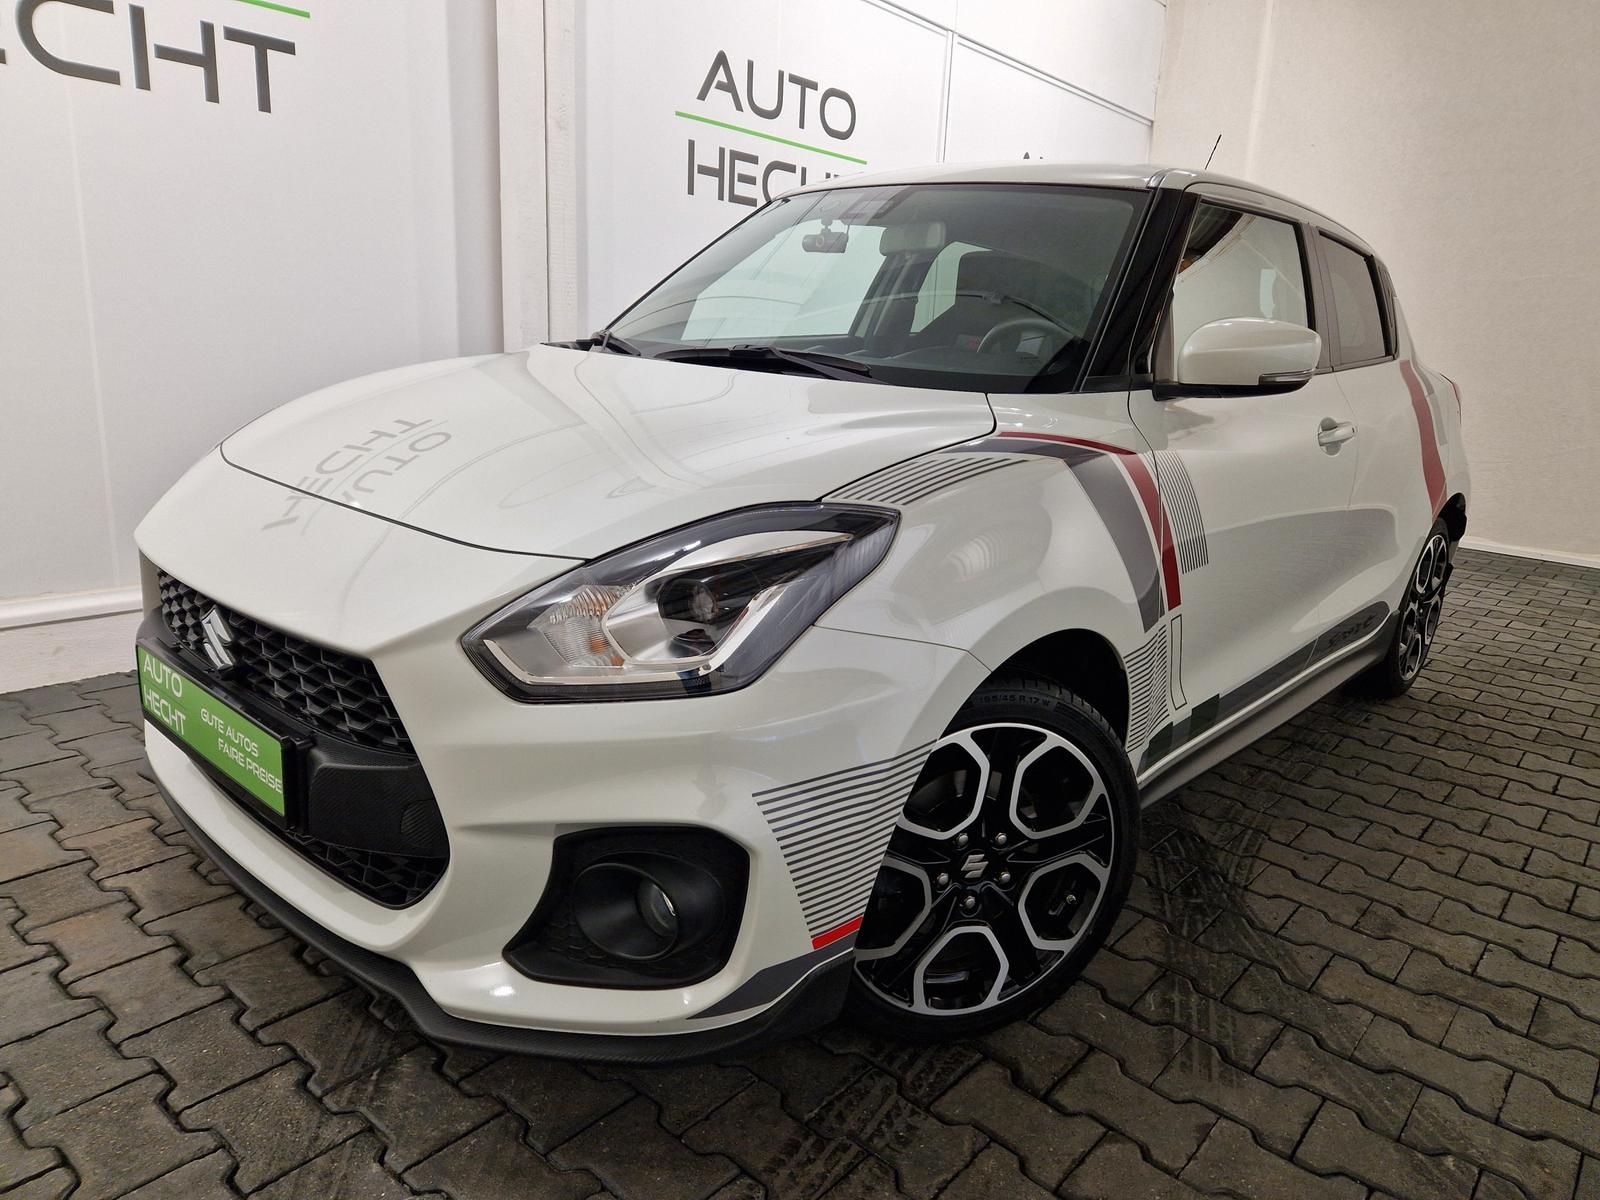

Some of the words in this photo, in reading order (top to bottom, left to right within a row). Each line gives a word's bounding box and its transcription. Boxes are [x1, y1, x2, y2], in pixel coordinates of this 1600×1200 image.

[0, 0, 297, 113] CHT
[696, 49, 857, 141] AUTO
[687, 138, 840, 208] HEC
[143, 654, 183, 698] AUTO
[143, 684, 186, 735] HECHT
[200, 708, 224, 735] GUTE
[225, 725, 259, 758] AUTOS
[217, 738, 245, 767] FAIRE
[246, 758, 283, 794] PREISE
